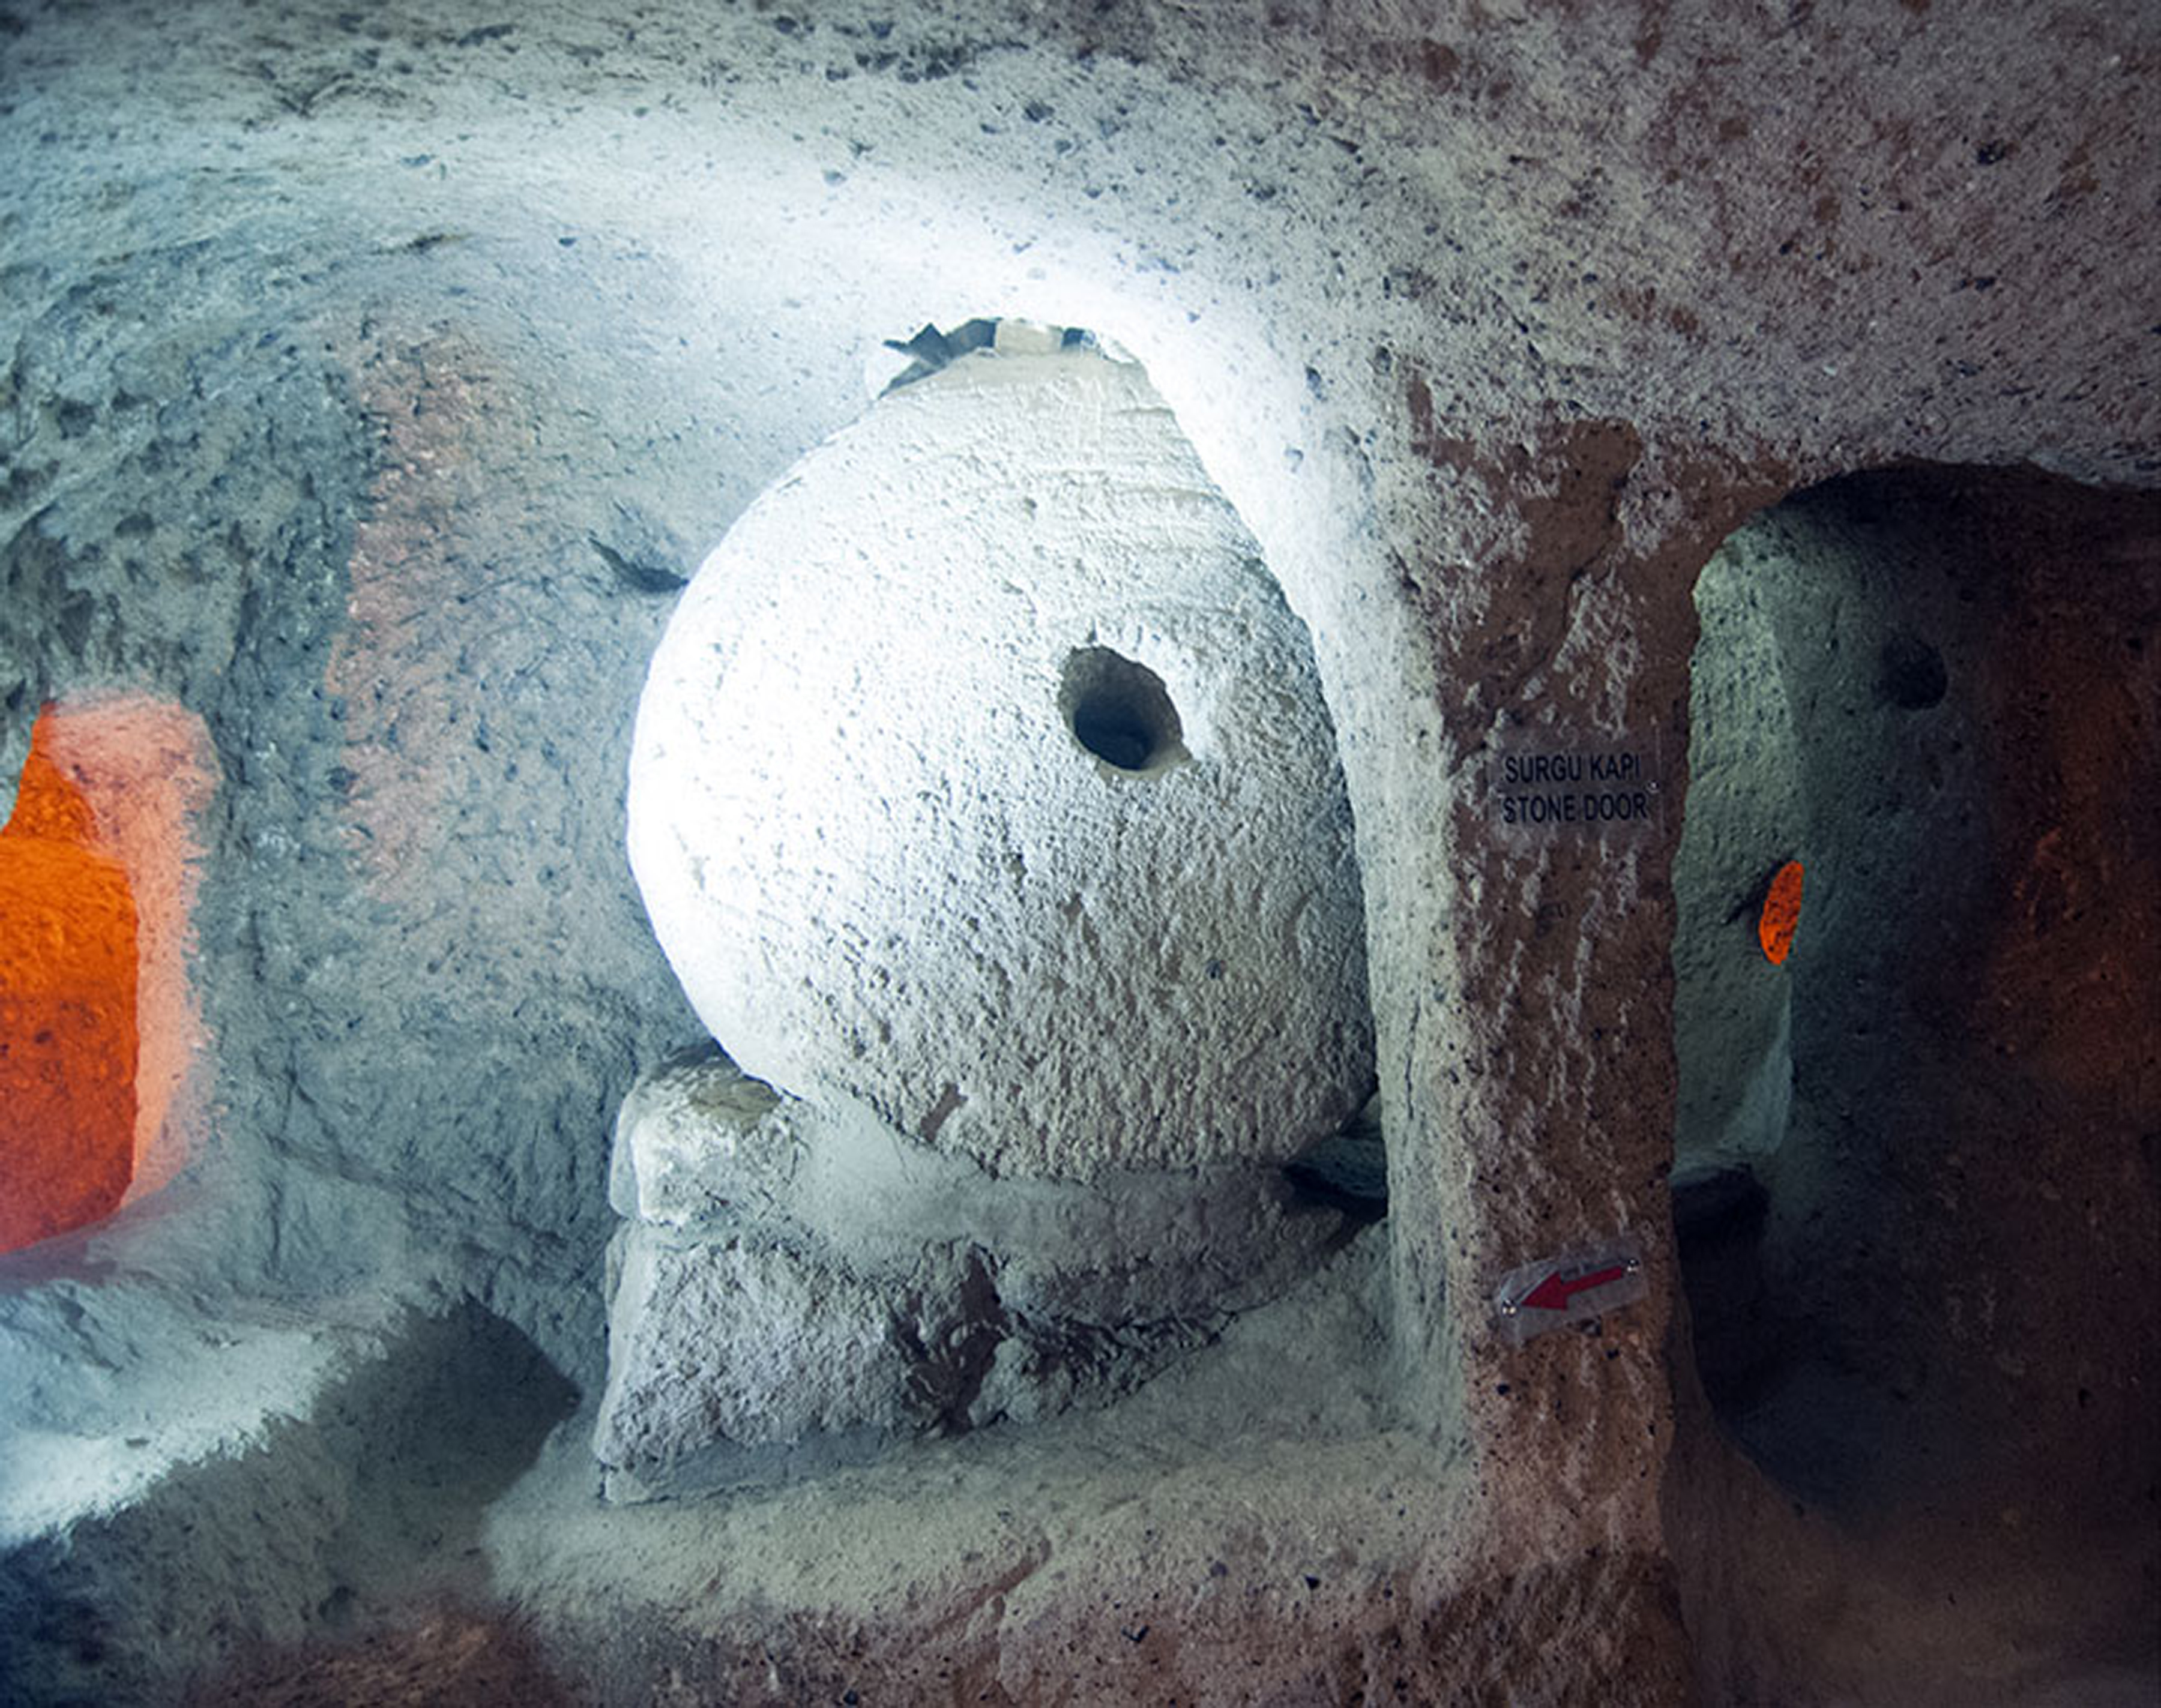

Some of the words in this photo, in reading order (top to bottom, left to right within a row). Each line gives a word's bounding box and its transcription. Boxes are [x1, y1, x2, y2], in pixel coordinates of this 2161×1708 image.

[1505, 755, 1582, 783] SURGU
[1590, 753, 1640, 780] KAPI
[1503, 795, 1576, 823] STONE
[1585, 792, 1648, 821] DOOR
